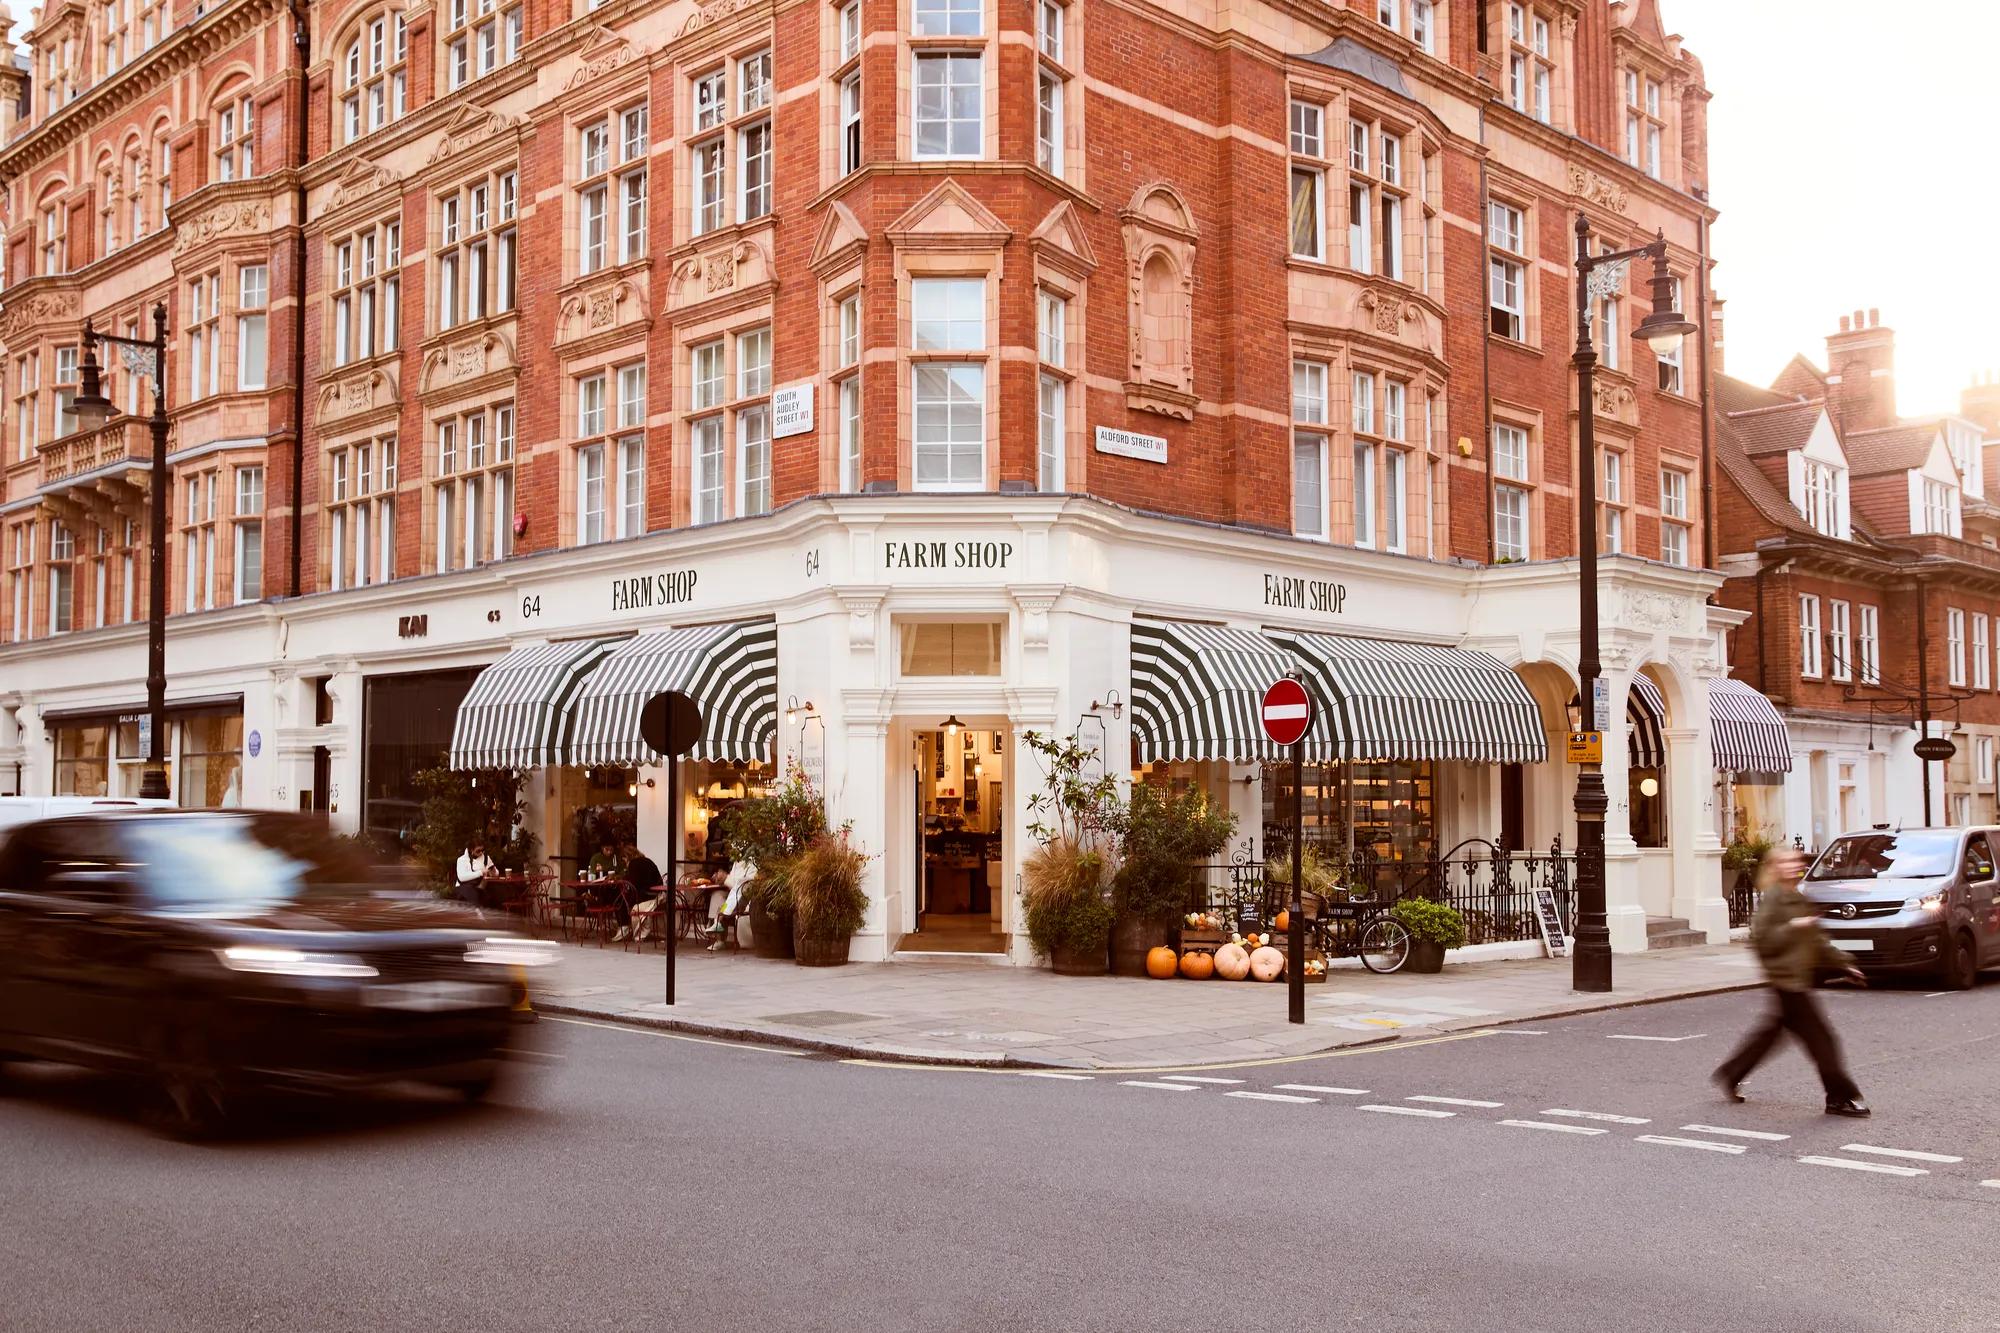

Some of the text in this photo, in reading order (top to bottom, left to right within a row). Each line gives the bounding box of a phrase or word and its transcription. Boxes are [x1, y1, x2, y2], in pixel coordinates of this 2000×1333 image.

[776, 391, 797, 404] SOUTH
[776, 401, 800, 414] AUDLEY
[776, 410, 809, 426] STREET W1
[1100, 431, 1164, 451] ALDFORD STREET W1
[806, 549, 819, 577] 64
[885, 542, 1013, 568] FARM SHOP
[612, 570, 698, 611] FARM SHOP
[1264, 573, 1347, 614] FARM SHOP
[487, 610, 501, 623] 65
[522, 595, 541, 618] 64
[398, 614, 428, 638] KAI
[330, 783, 339, 798] 65
